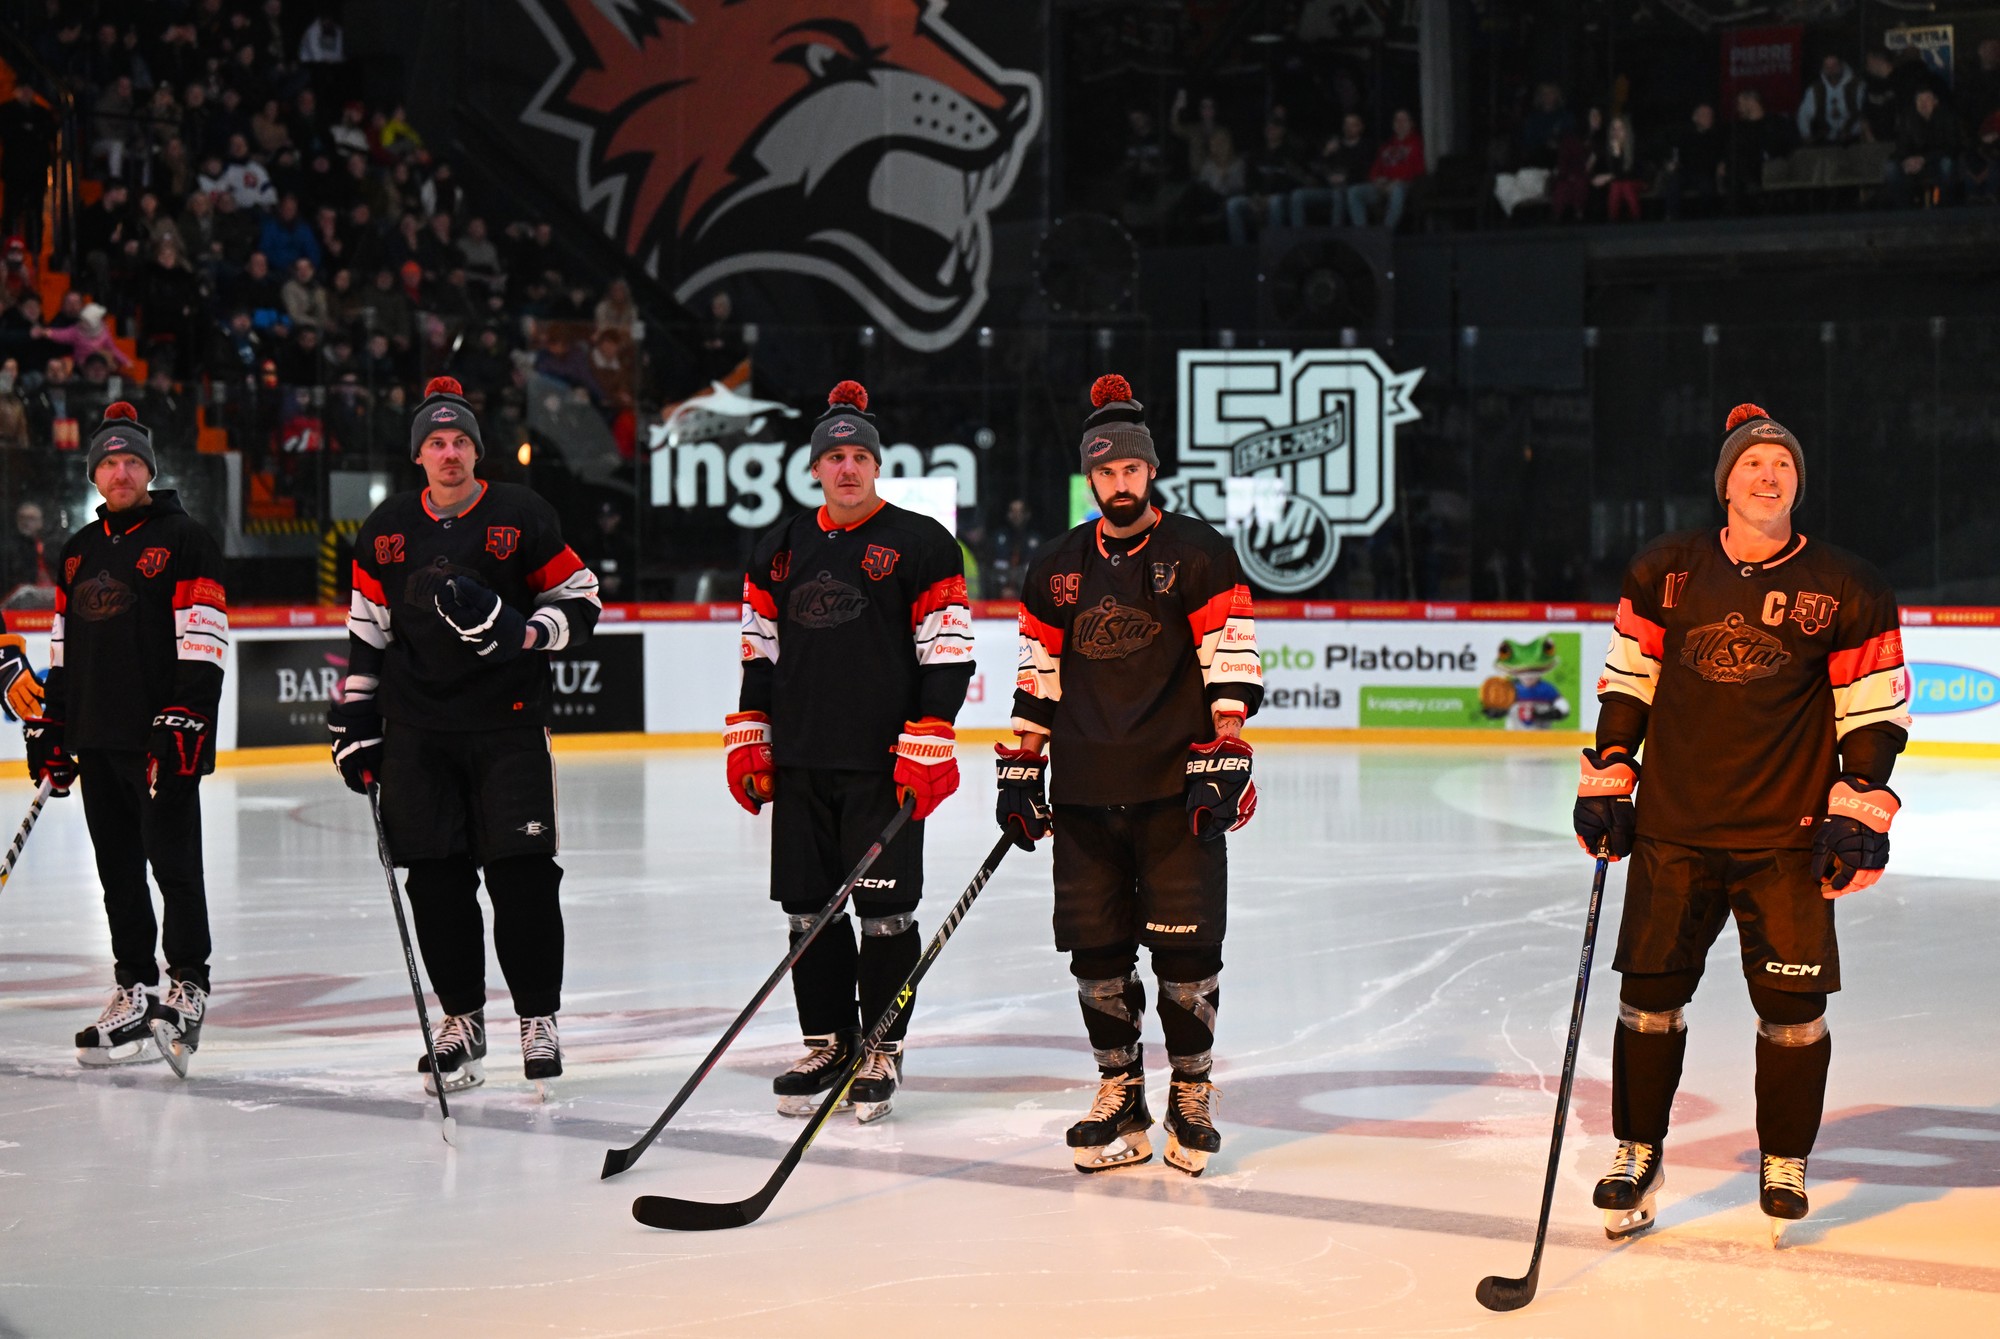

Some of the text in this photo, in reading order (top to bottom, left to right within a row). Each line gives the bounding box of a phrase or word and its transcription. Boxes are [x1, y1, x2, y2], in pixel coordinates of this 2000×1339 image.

[1177, 350, 1396, 537] 50
[374, 533, 406, 565] 82
[864, 543, 898, 574] 50
[1050, 573, 1083, 607] 99
[1662, 571, 1689, 609] 17
[1761, 590, 1788, 627] C
[1795, 591, 1835, 629] 50
[1096, 612, 1161, 646] Star
[182, 640, 216, 654] Orange
[1260, 643, 1479, 675] pto Platobné
[1681, 632, 1788, 668] All Star
[551, 660, 602, 695] UZ
[1220, 661, 1256, 675] Orange
[1261, 681, 1341, 709] enia
[1917, 674, 1995, 702] radio
[152, 714, 205, 732] CCM
[997, 766, 1041, 781] UER
[1186, 757, 1250, 775] BAUER
[1580, 774, 1629, 788] STON
[1829, 796, 1891, 821] EASTON
[1145, 922, 1198, 934] BAUER
[1765, 961, 1822, 977] CCM
[864, 983, 914, 1058] ALPHA LX
[1563, 1021, 1577, 1072] HYPRLITE
